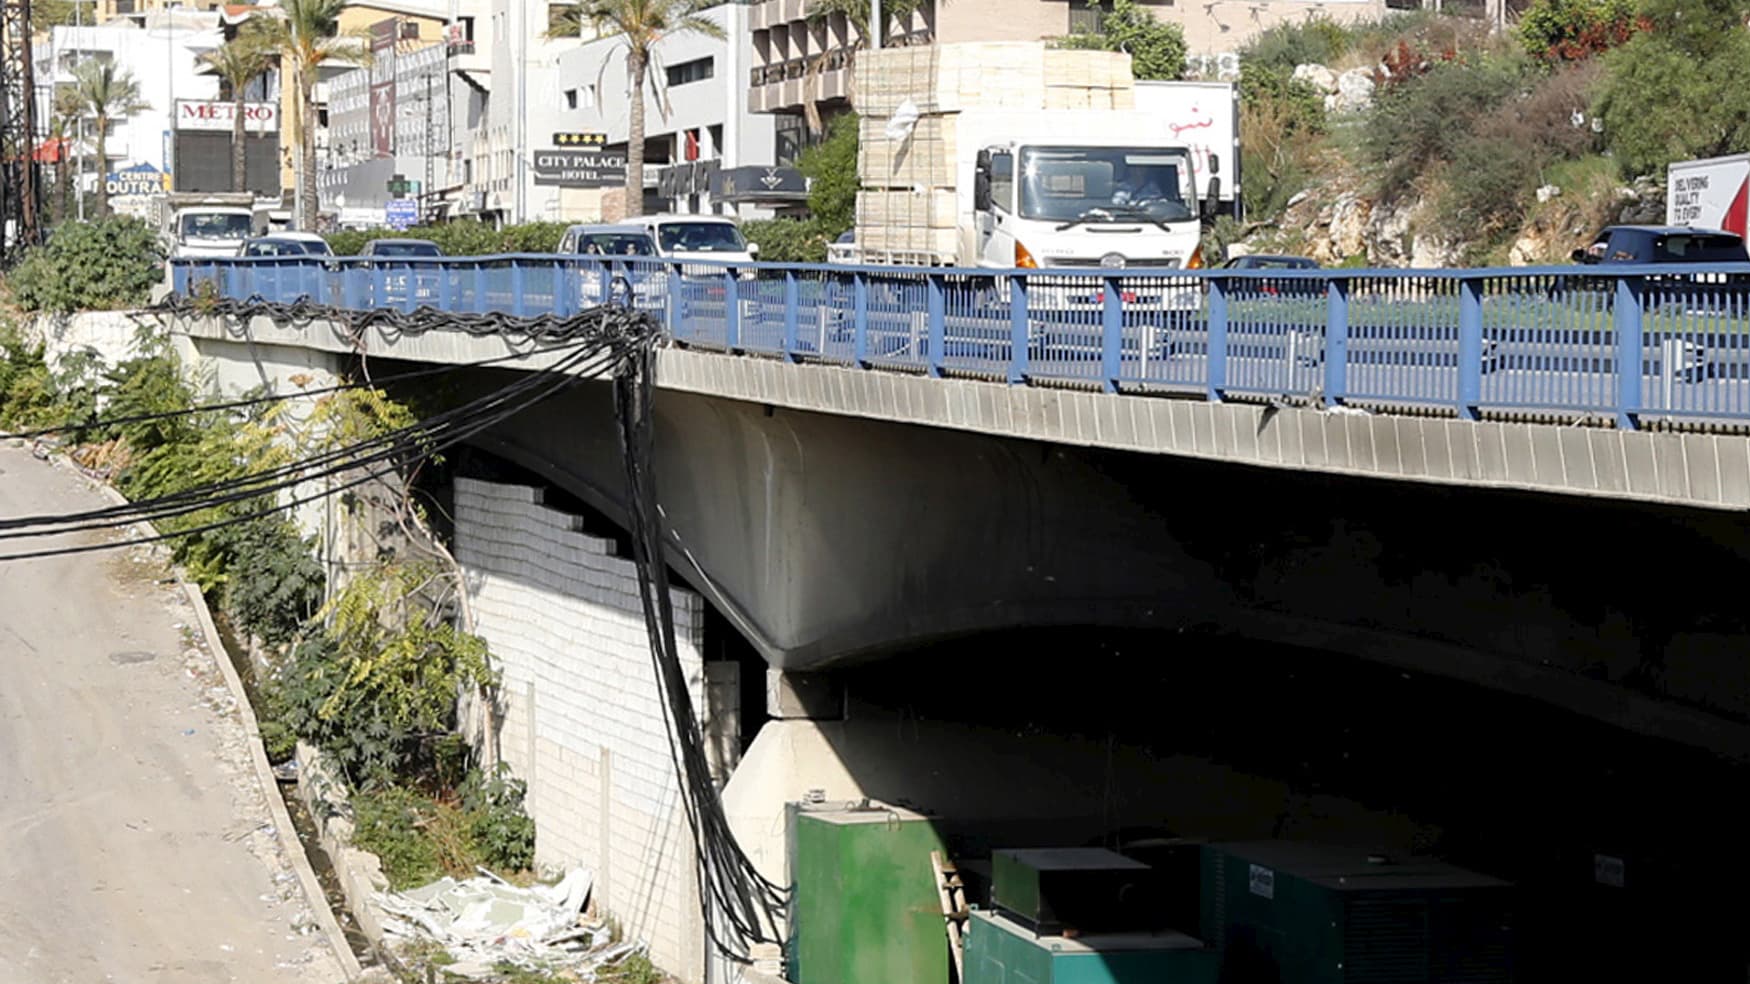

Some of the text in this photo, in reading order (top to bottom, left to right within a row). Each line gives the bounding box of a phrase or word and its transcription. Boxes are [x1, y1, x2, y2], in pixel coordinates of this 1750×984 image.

[182, 104, 273, 121] METRO
[538, 156, 625, 168] CITY PALACE
[561, 170, 601, 180] HOTEL
